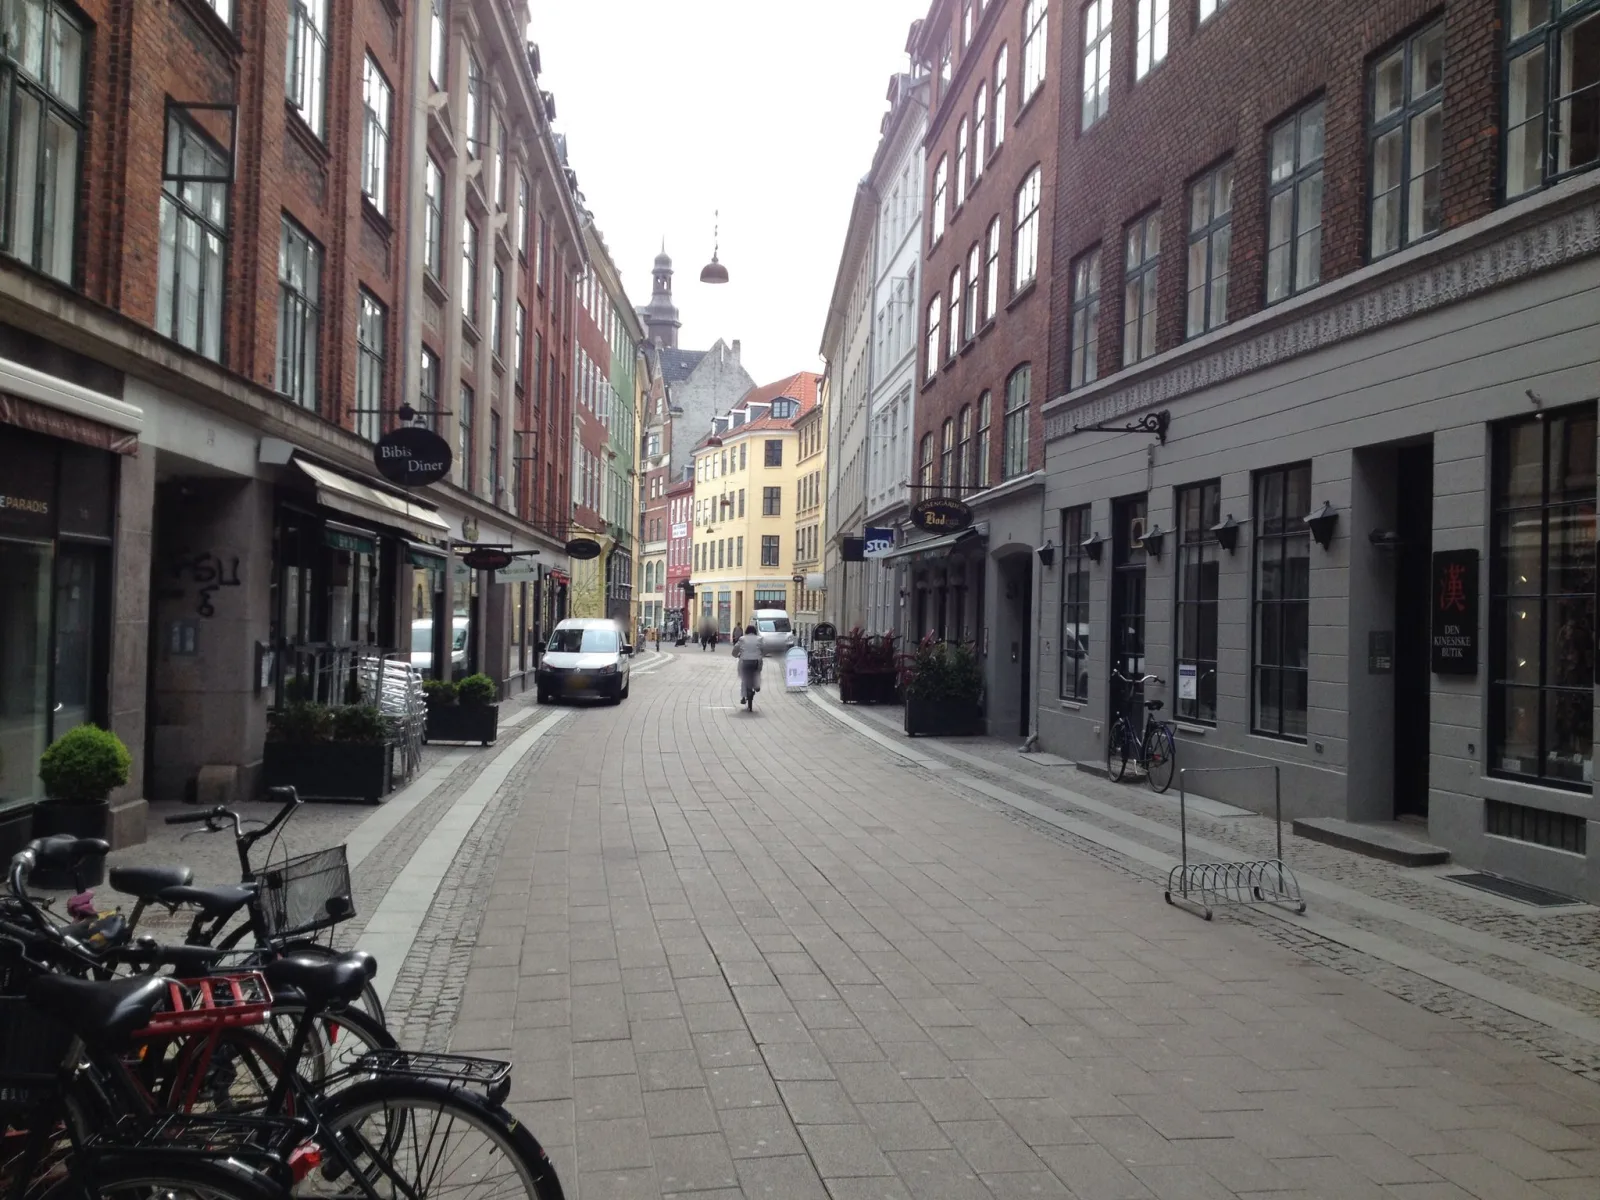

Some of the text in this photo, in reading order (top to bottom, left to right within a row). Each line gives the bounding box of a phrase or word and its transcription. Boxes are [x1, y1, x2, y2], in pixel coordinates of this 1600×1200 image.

[381, 446, 412, 458] Bibis
[408, 460, 443, 472] Diner
[1444, 625, 1460, 635] DEN
[1434, 636, 1471, 647] KINESISKE
[1441, 647, 1463, 657] BUTIK
